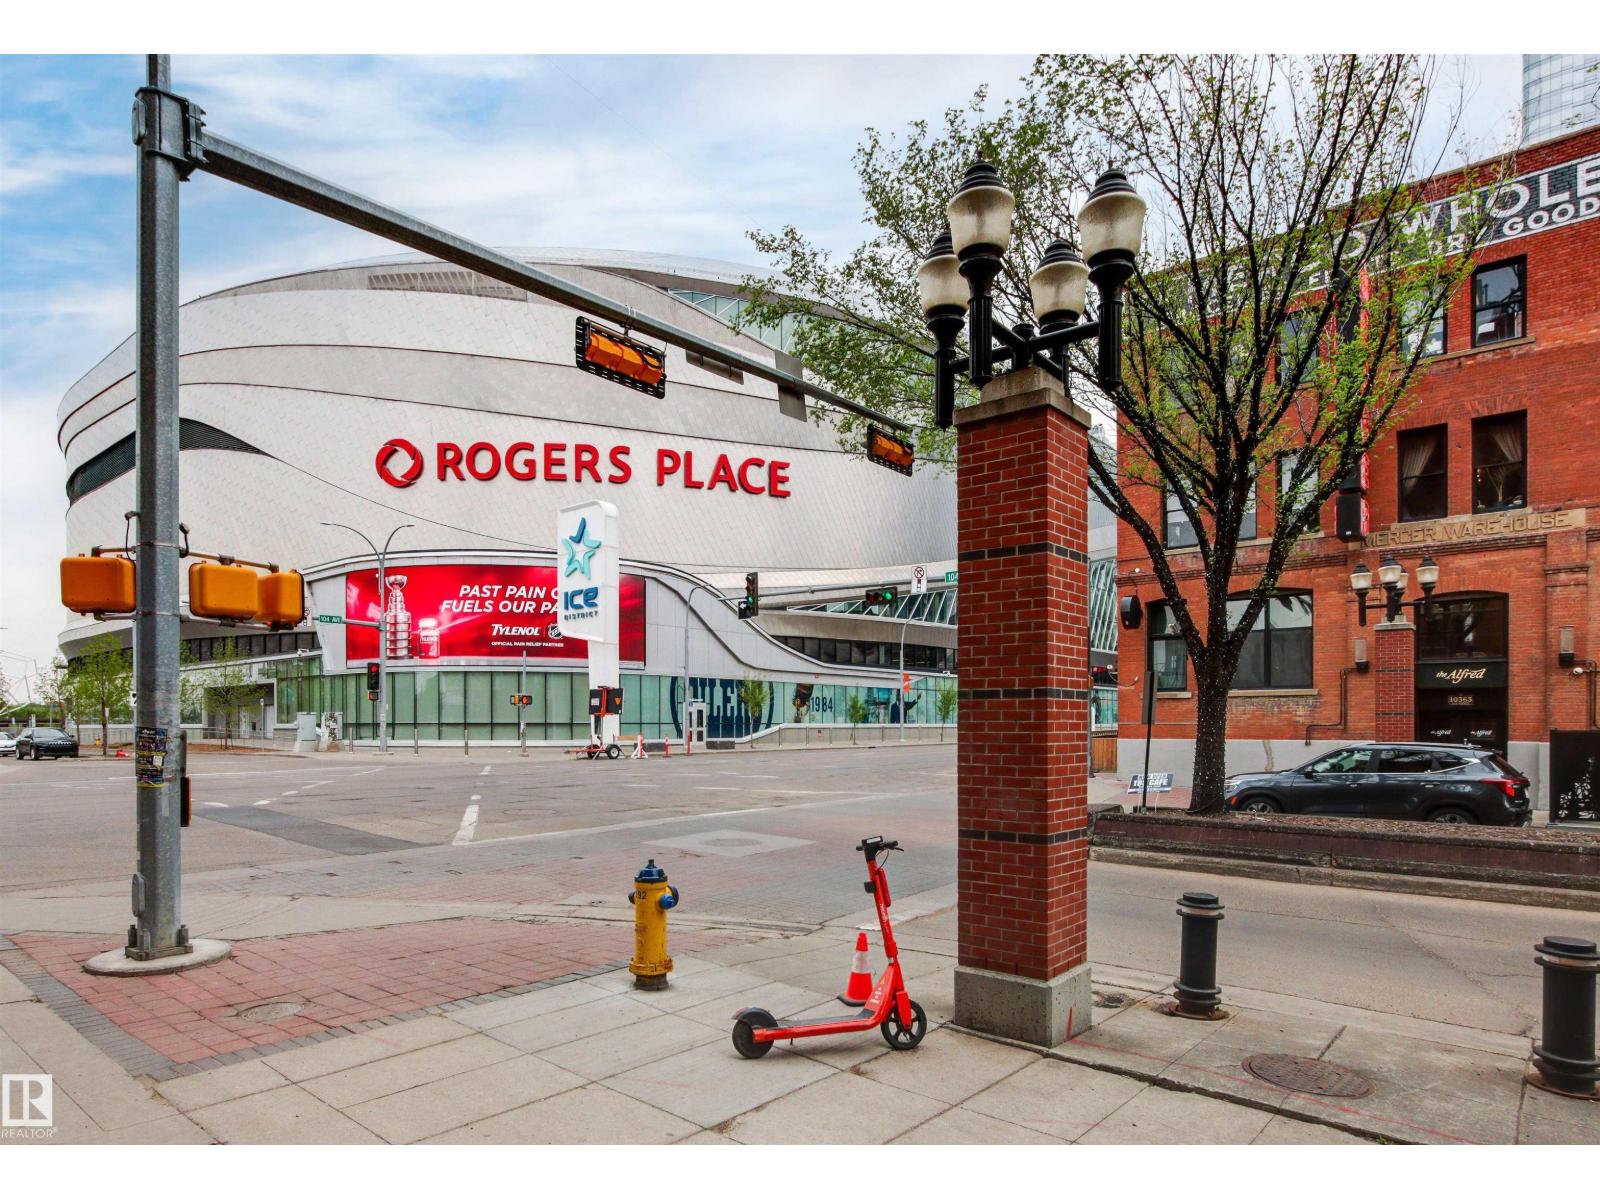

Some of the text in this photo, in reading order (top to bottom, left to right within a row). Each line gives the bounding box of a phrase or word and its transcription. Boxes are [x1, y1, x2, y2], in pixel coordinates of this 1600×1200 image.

[436, 441, 791, 498] ROGERS PLACE
[1361, 513, 1572, 549] MERCER WAREHOUSE
[459, 585, 502, 598] PAST
[505, 586, 547, 599] PAIN
[441, 600, 493, 613] FUELS
[499, 601, 535, 614] OUR
[563, 610, 599, 621] DISTRICT
[491, 623, 540, 636] TYLENOL
[1445, 668, 1486, 684] Alfred
[811, 696, 833, 713] 1984
